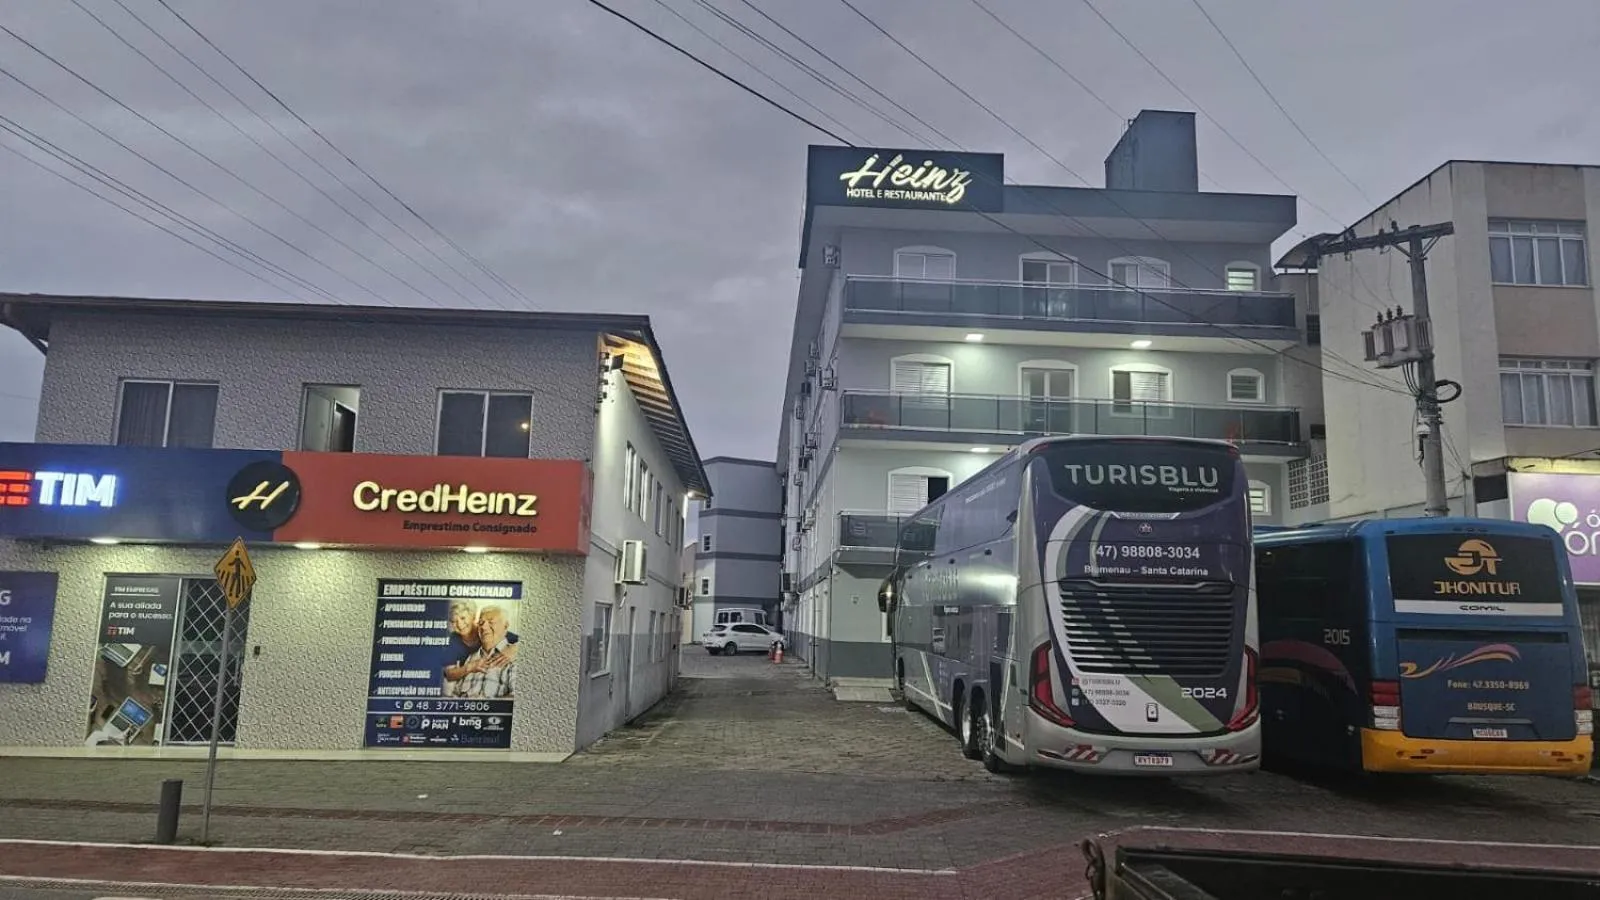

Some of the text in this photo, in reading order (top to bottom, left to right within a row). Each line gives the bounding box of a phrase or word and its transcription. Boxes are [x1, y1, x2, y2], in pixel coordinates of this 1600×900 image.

[839, 153, 973, 203] Heinz
[846, 188, 946, 202] HOTEL E RESTAURANTE
[1064, 464, 1218, 487] TURISBLU
[35, 471, 117, 508] TIM
[353, 480, 537, 516] CredHeinz
[403, 519, 537, 535] Emprestimo Consignado
[1121, 545, 1200, 559] 98808-3034
[1141, 565, 1168, 575] Santa
[1170, 566, 1209, 576] Catarina
[383, 583, 513, 598] EMPRÉSTIMO CONSIGNADO
[1433, 581, 1521, 595] JHONITUR
[134, 602, 162, 610] aliada
[109, 612, 129, 620] para
[118, 627, 135, 635] TIM
[1323, 628, 1350, 645] 2015
[1447, 679, 1471, 689] Fone:
[1181, 687, 1228, 699] 2024
[416, 701, 490, 712] 48. 3771-9806
[459, 717, 482, 730] bmg
